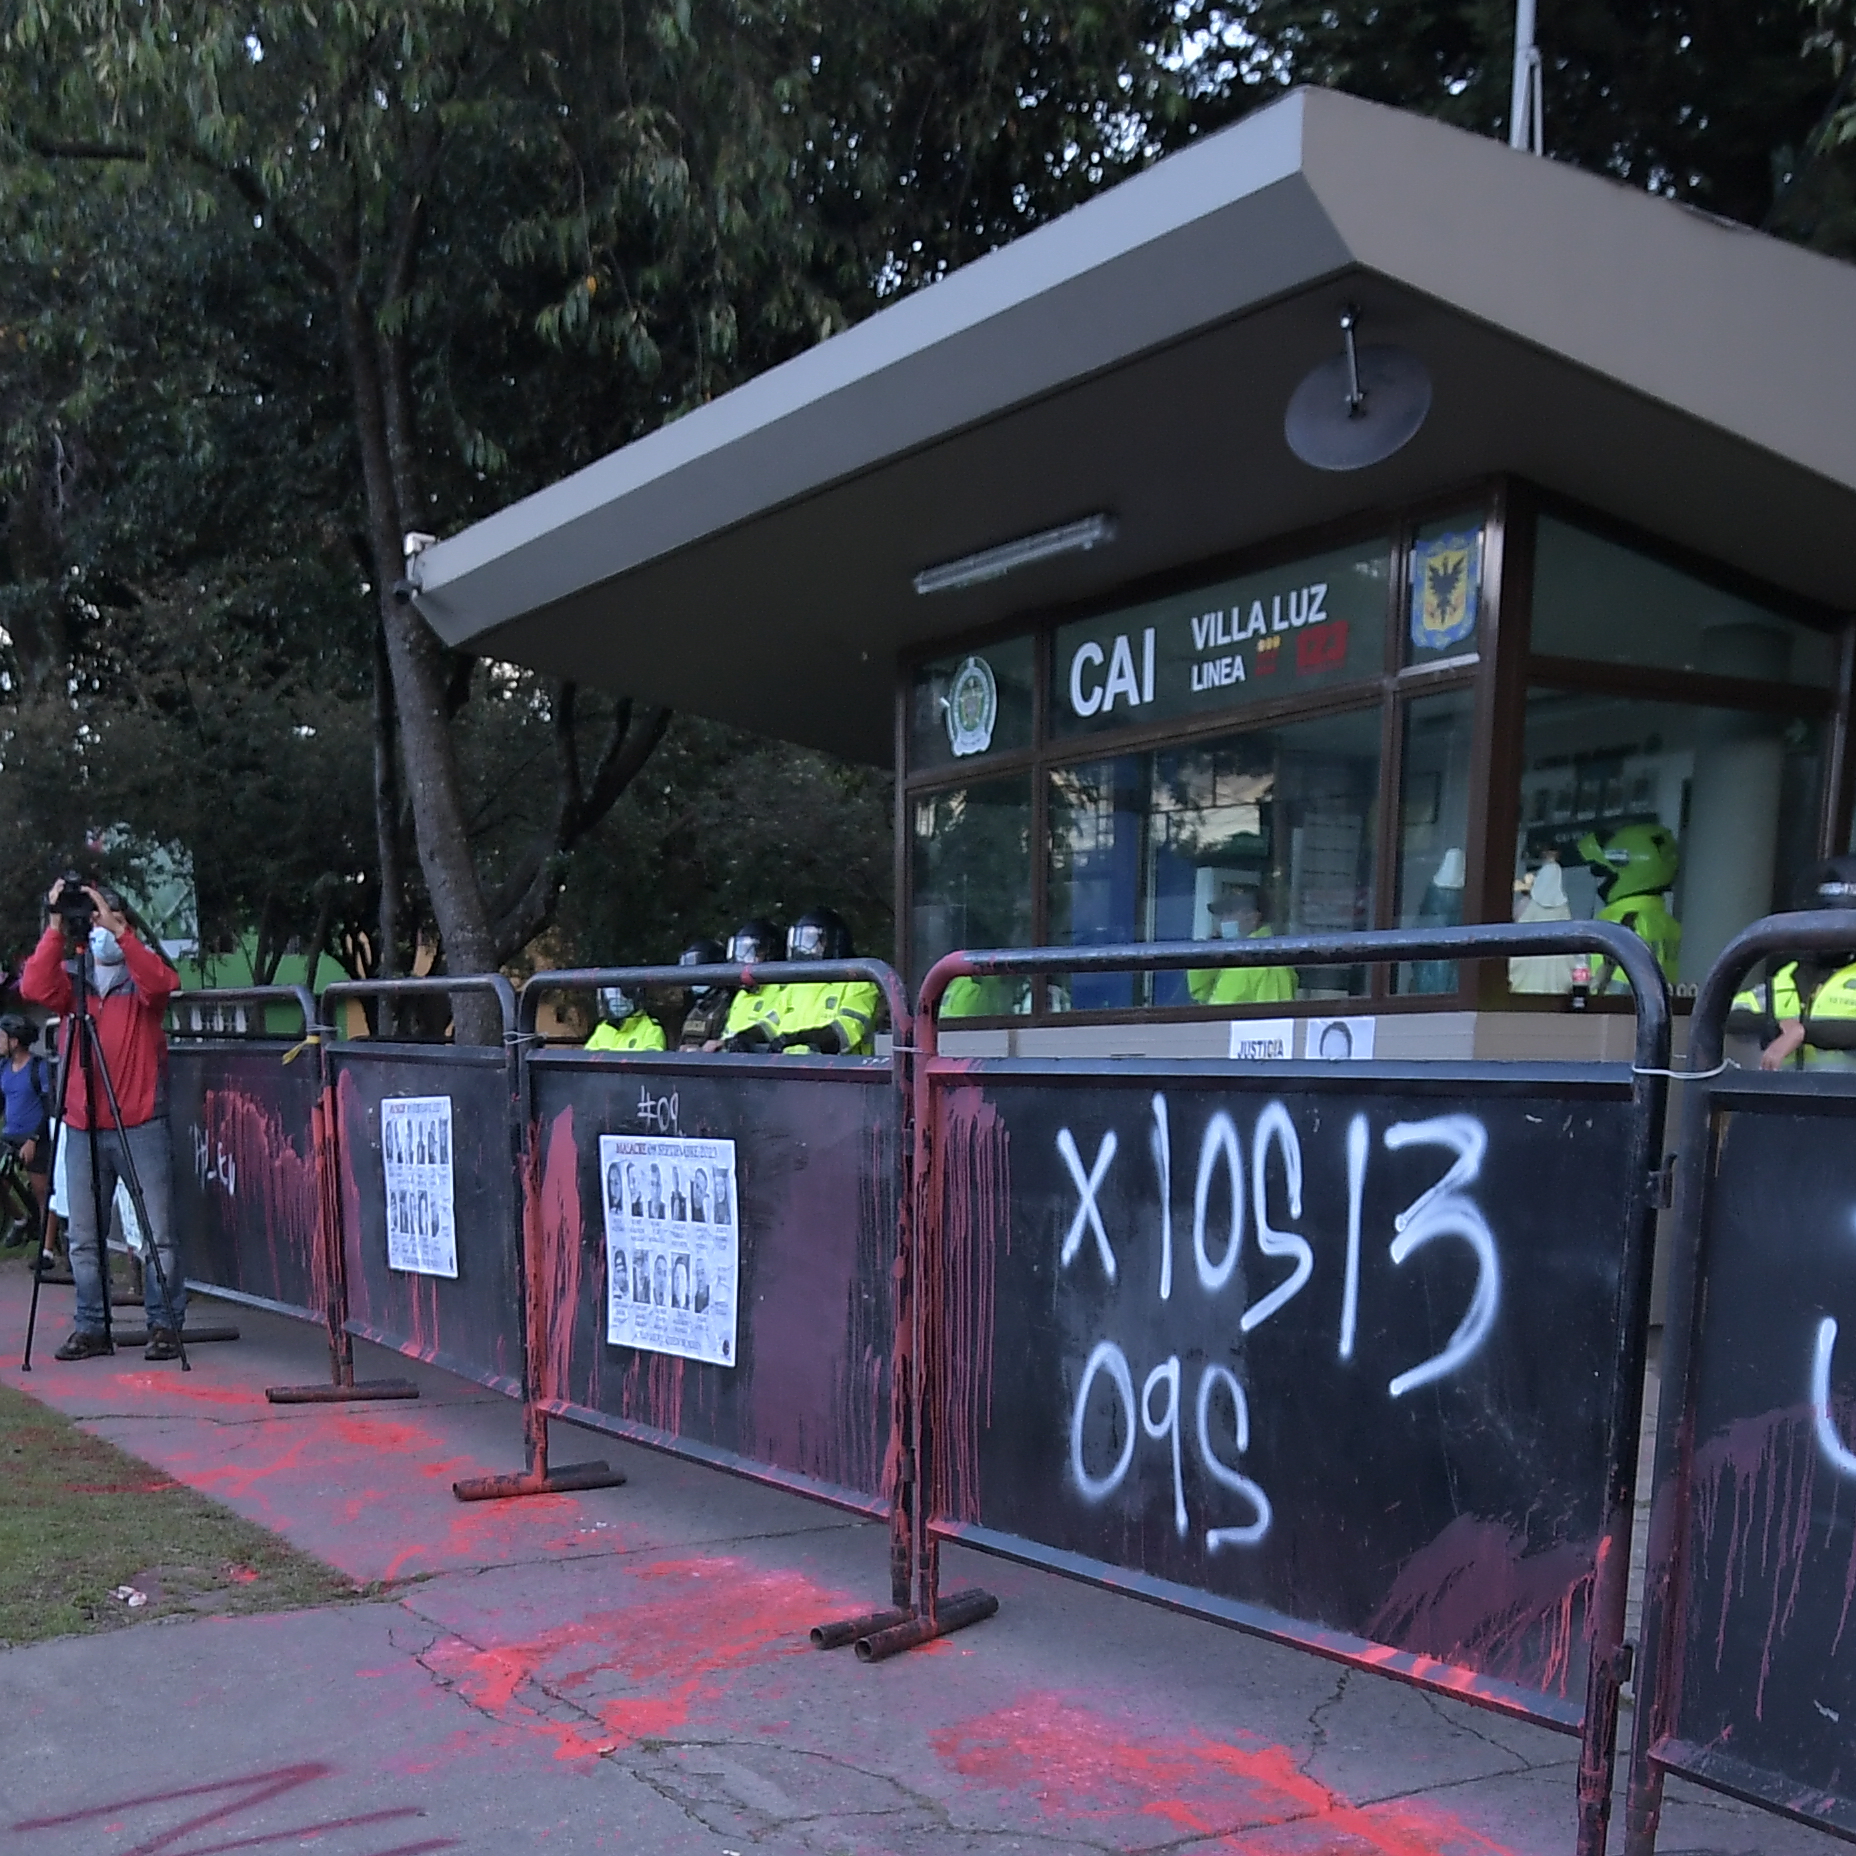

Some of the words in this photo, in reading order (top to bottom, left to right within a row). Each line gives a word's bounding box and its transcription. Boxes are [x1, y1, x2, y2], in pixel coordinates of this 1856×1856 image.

[1191, 600, 1266, 651] VILLA
[1272, 583, 1328, 632] LUZ
[1069, 627, 1156, 717] CAI
[1192, 654, 1246, 692] LINEA
[1237, 1039, 1284, 1058] JUSTICIA
